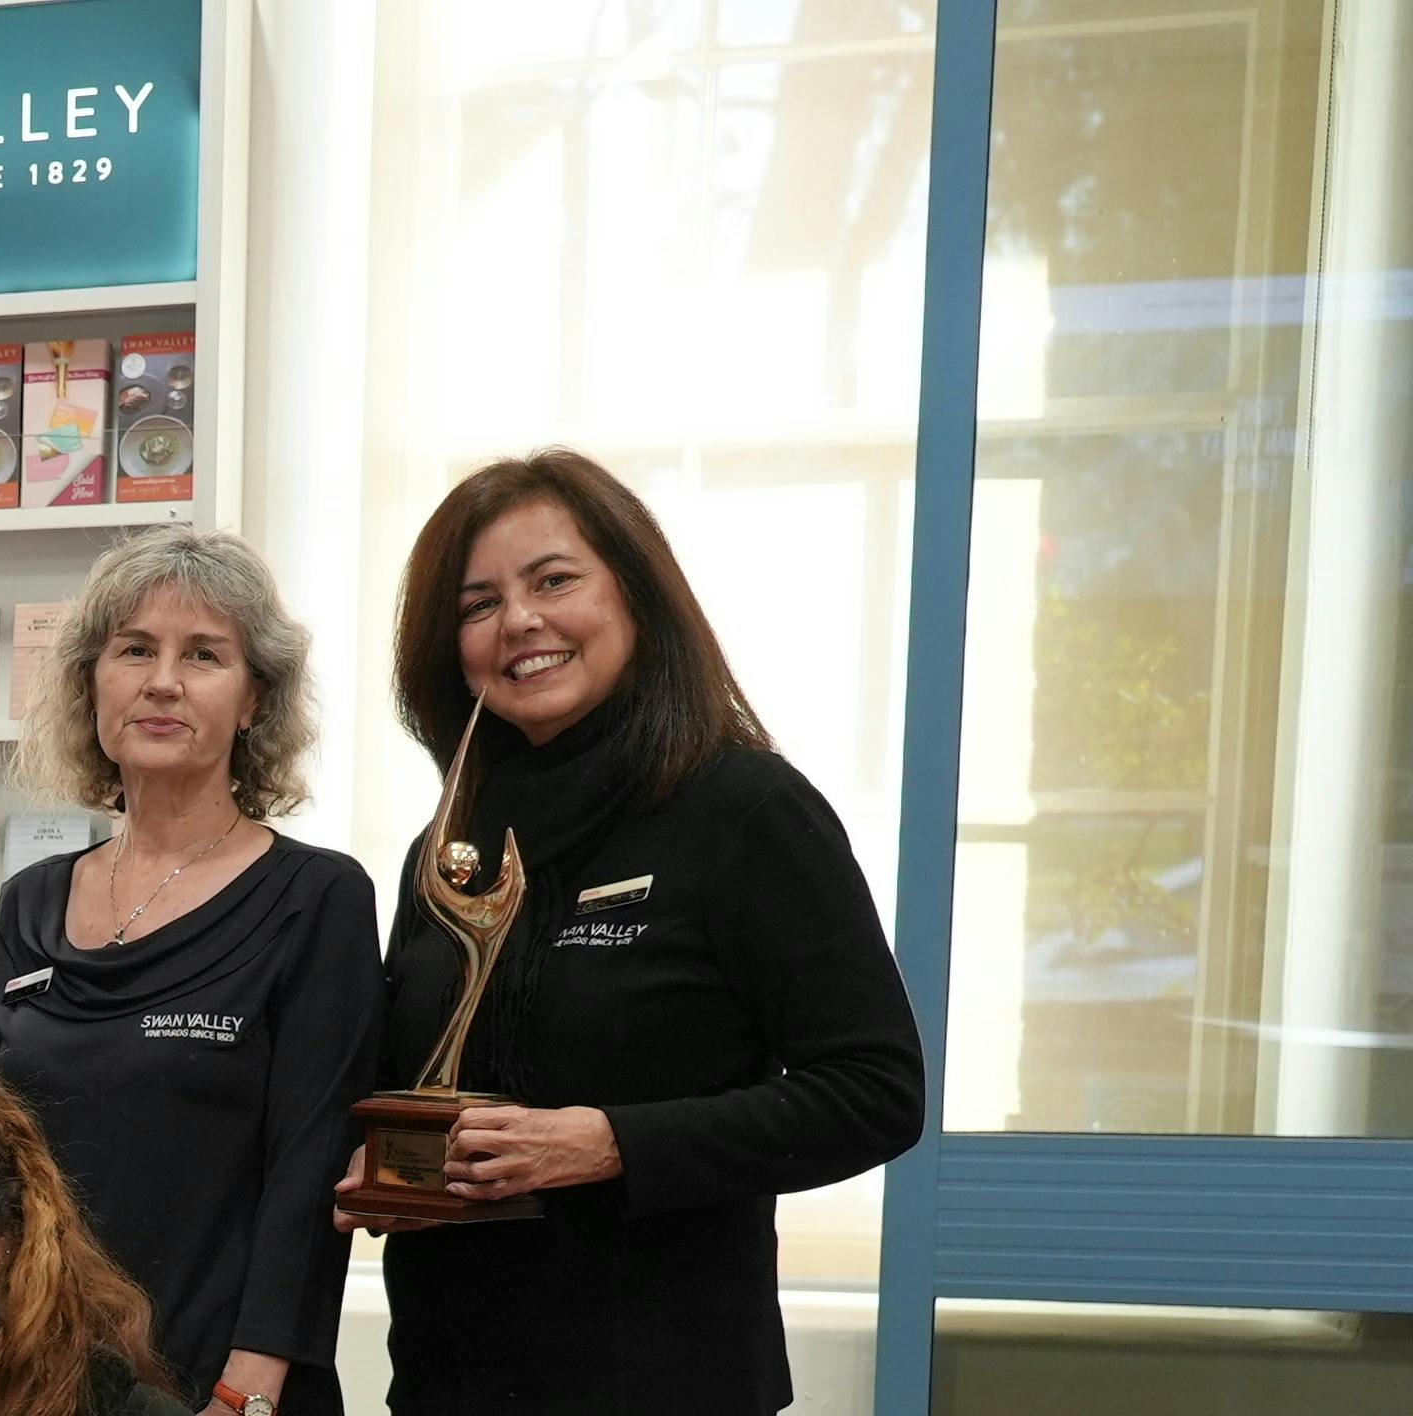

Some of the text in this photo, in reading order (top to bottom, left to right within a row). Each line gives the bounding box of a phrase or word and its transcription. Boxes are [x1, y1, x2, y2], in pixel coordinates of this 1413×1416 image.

[29, 157, 113, 187] 1829
[591, 923, 648, 938] VALLEY
[140, 1013, 243, 1031] SWAN VALLEY
[144, 1028, 188, 1038] VINEYARDS
[189, 1029, 215, 1040] SINCE
